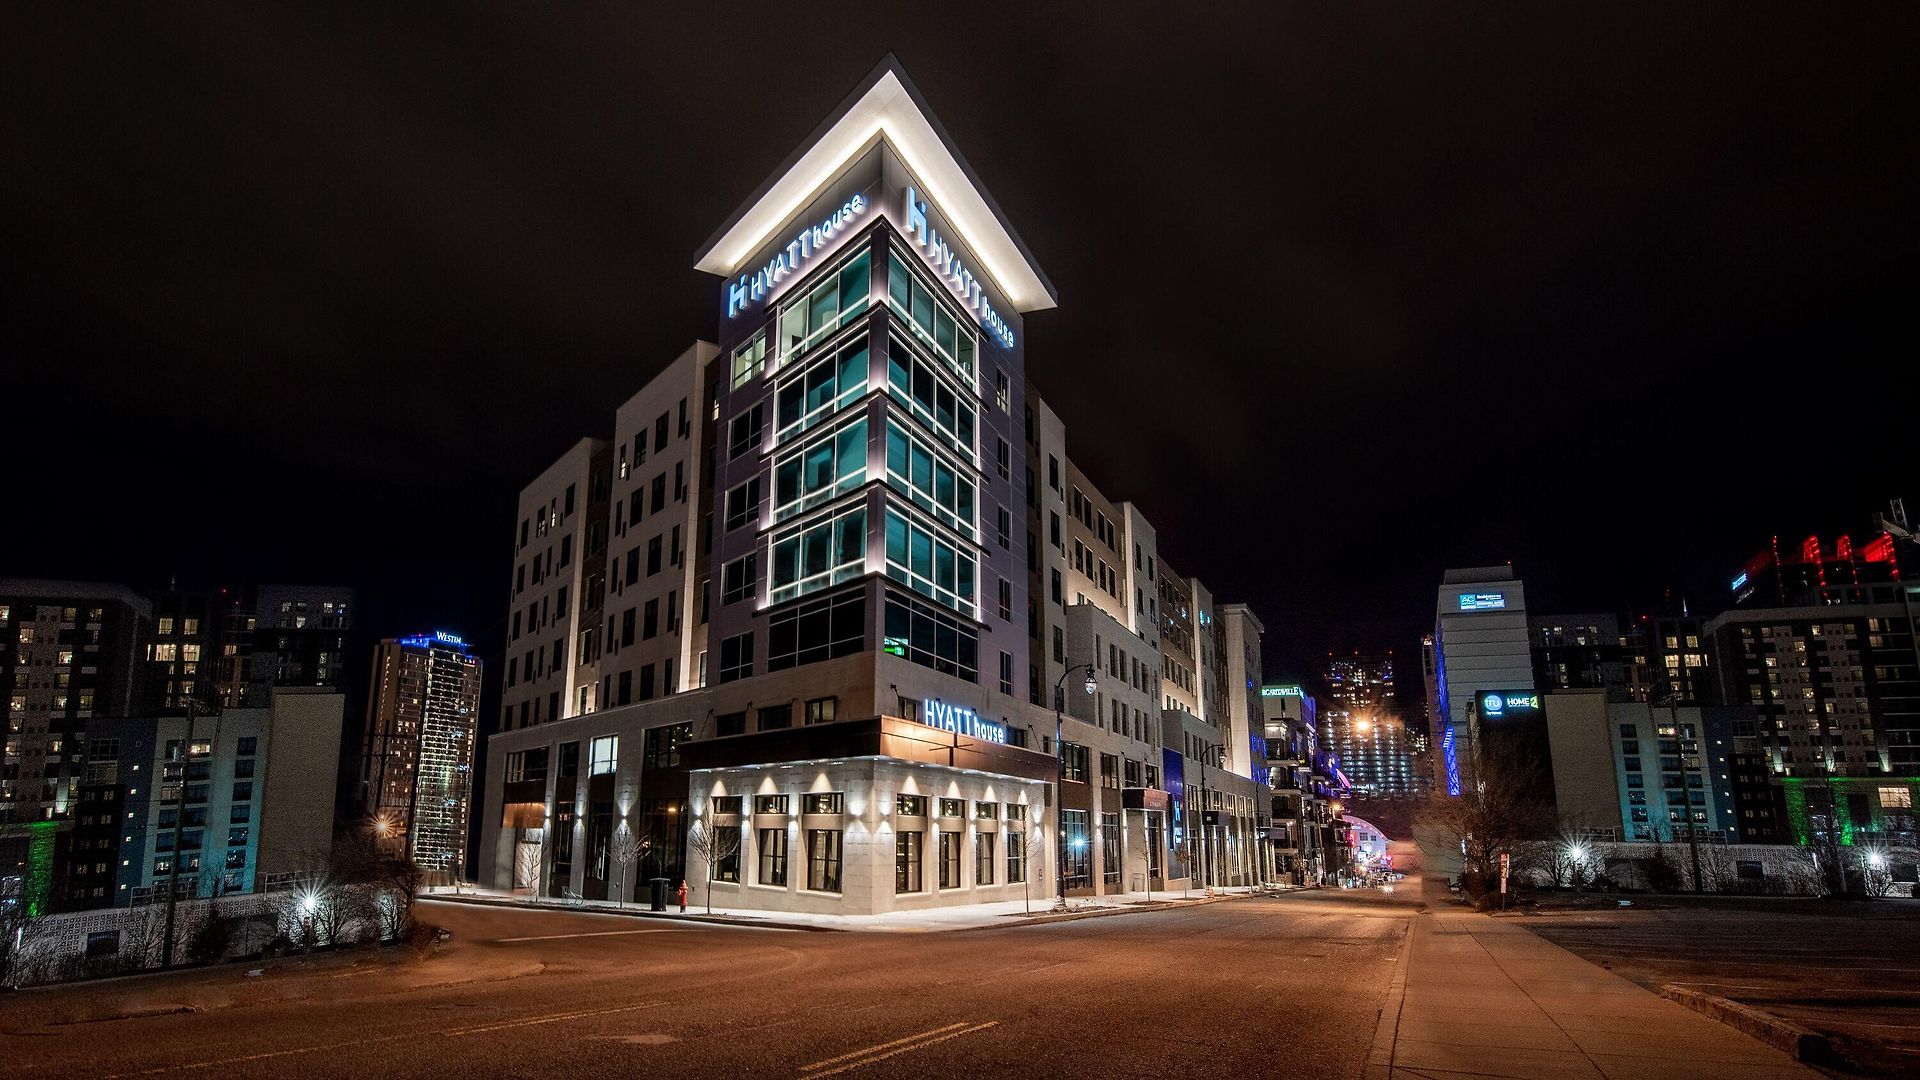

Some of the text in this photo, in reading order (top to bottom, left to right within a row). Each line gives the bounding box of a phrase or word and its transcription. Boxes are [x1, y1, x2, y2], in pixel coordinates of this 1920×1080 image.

[750, 229, 812, 300] HYATT
[812, 194, 865, 248] house
[927, 228, 982, 309] HYATT
[981, 295, 1014, 348] house
[436, 631, 462, 644] WESTIN
[1485, 697, 1500, 707] tru
[1507, 695, 1539, 709] HOME 2
[925, 699, 1004, 744] HYATT house
